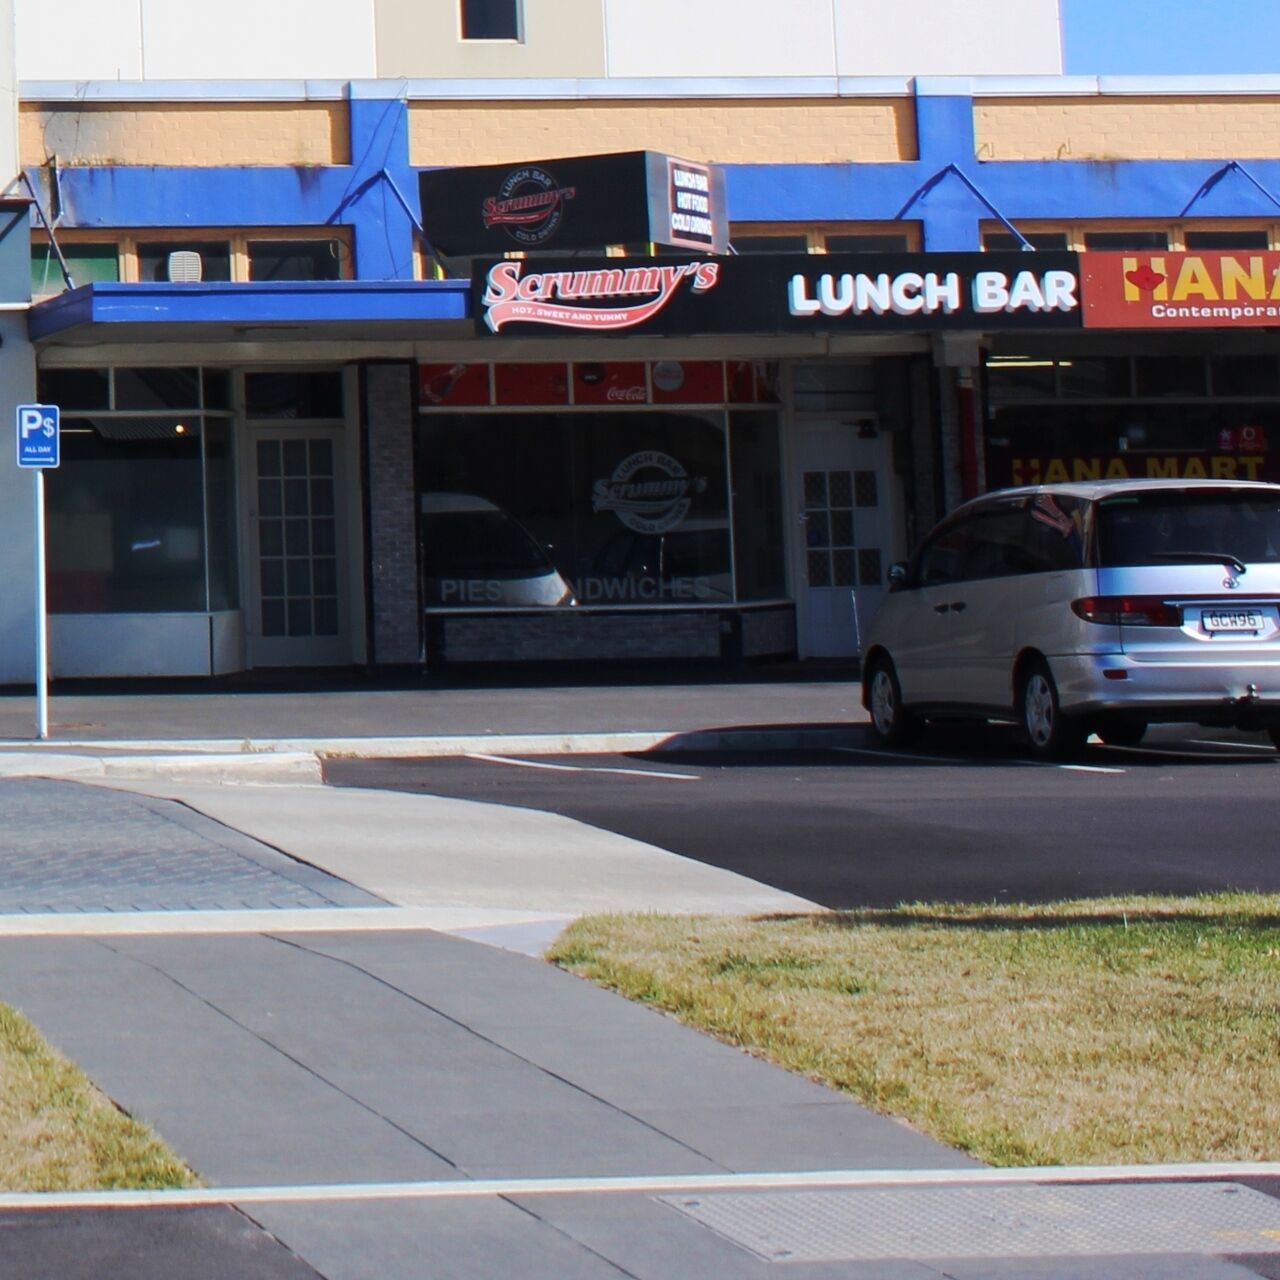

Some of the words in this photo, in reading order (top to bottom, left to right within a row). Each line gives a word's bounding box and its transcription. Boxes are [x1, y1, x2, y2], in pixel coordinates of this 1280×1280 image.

[501, 169, 529, 197] LUNCH
[531, 170, 552, 188] BAR
[515, 230, 537, 241] COLD
[482, 261, 720, 308] Scrummy's
[1122, 256, 1280, 301] HAN
[789, 272, 961, 315] LUNCH
[973, 270, 1078, 313] BAR
[511, 306, 536, 315] HOT,
[536, 308, 571, 318] SWEET
[571, 312, 592, 320] AND
[593, 313, 628, 321] YUMMY
[1151, 304, 1280, 319] Contempora
[616, 454, 653, 480] LUNCH
[656, 454, 681, 475] BAR
[1145, 455, 1265, 481] MART
[440, 579, 503, 602] PIES
